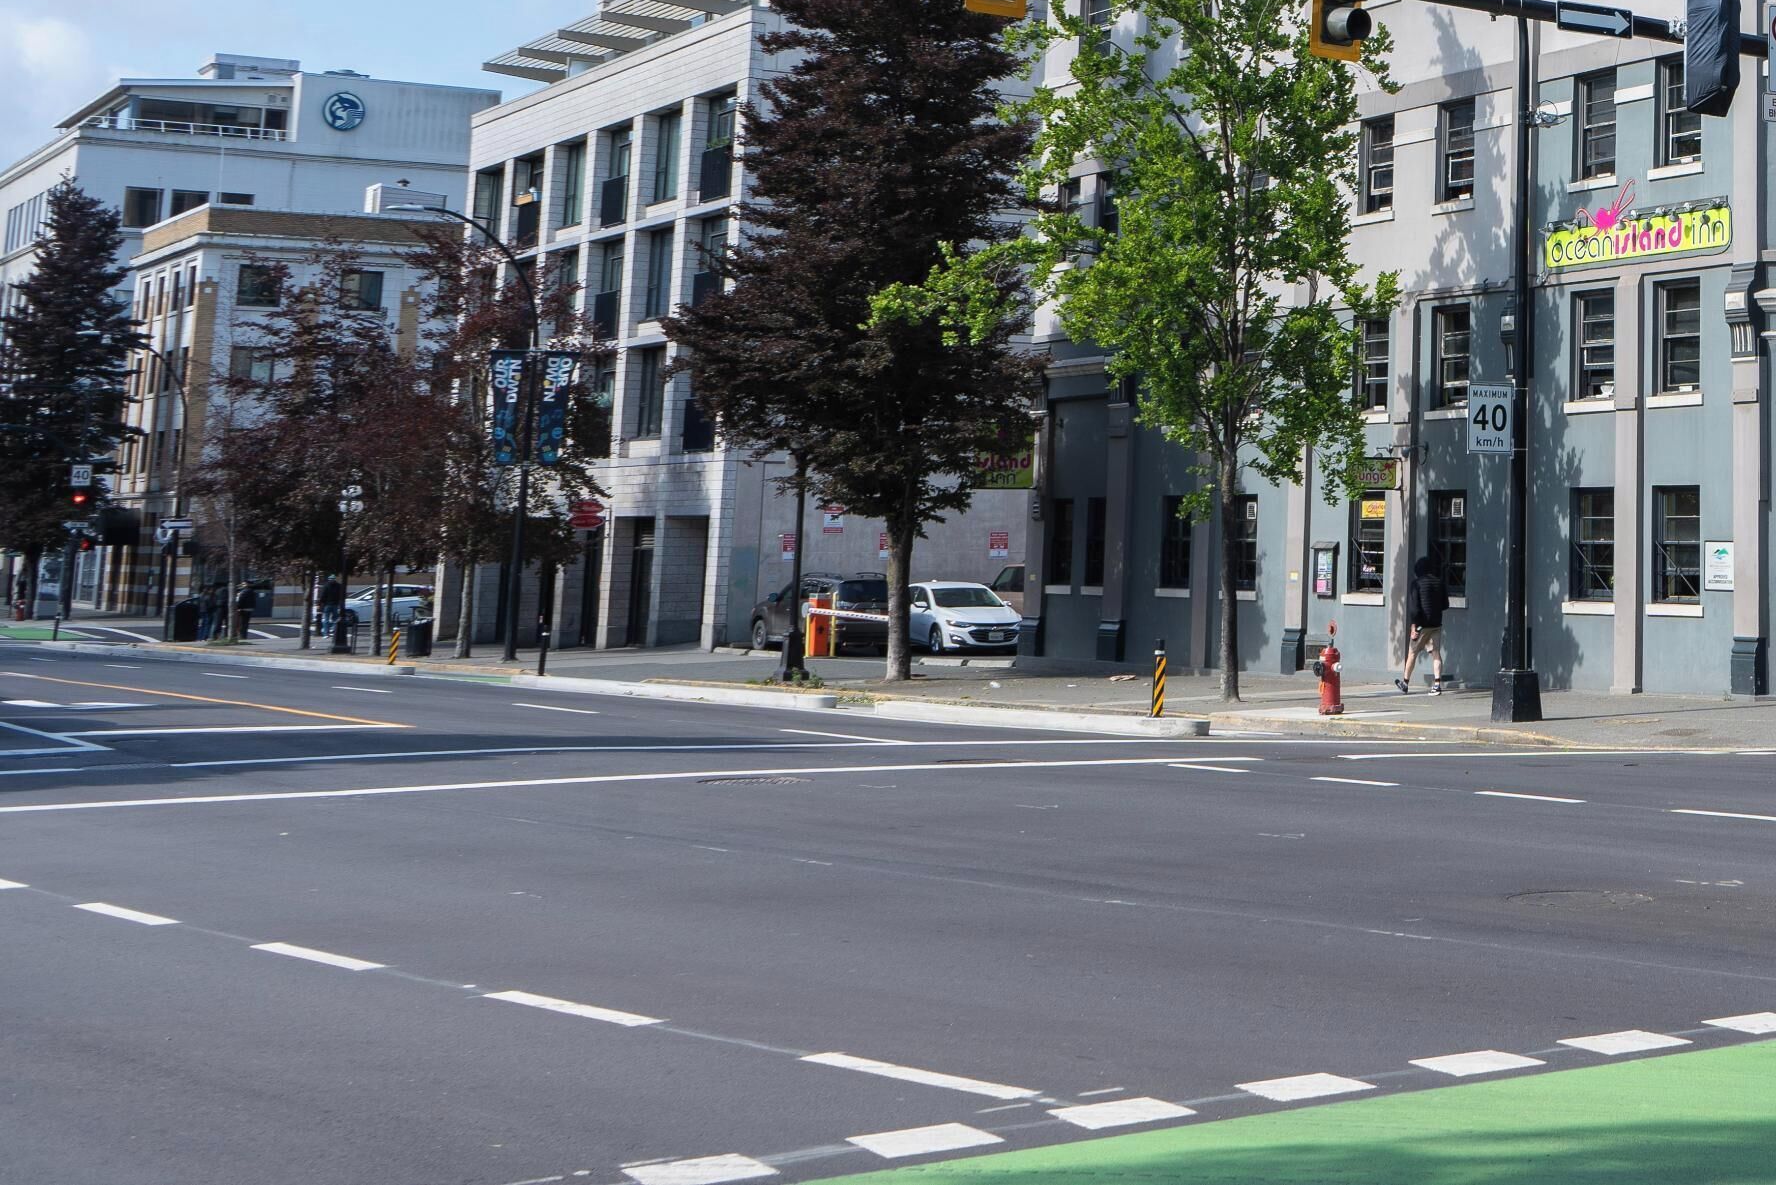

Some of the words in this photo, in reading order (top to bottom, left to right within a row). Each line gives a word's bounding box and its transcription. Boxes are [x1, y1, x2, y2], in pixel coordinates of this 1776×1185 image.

[1692, 217, 1725, 245] inn
[1472, 390, 1508, 399] MAXIMUM
[1473, 404, 1508, 432] 40
[1476, 436, 1504, 448] km/h
[73, 469, 90, 481] 40
